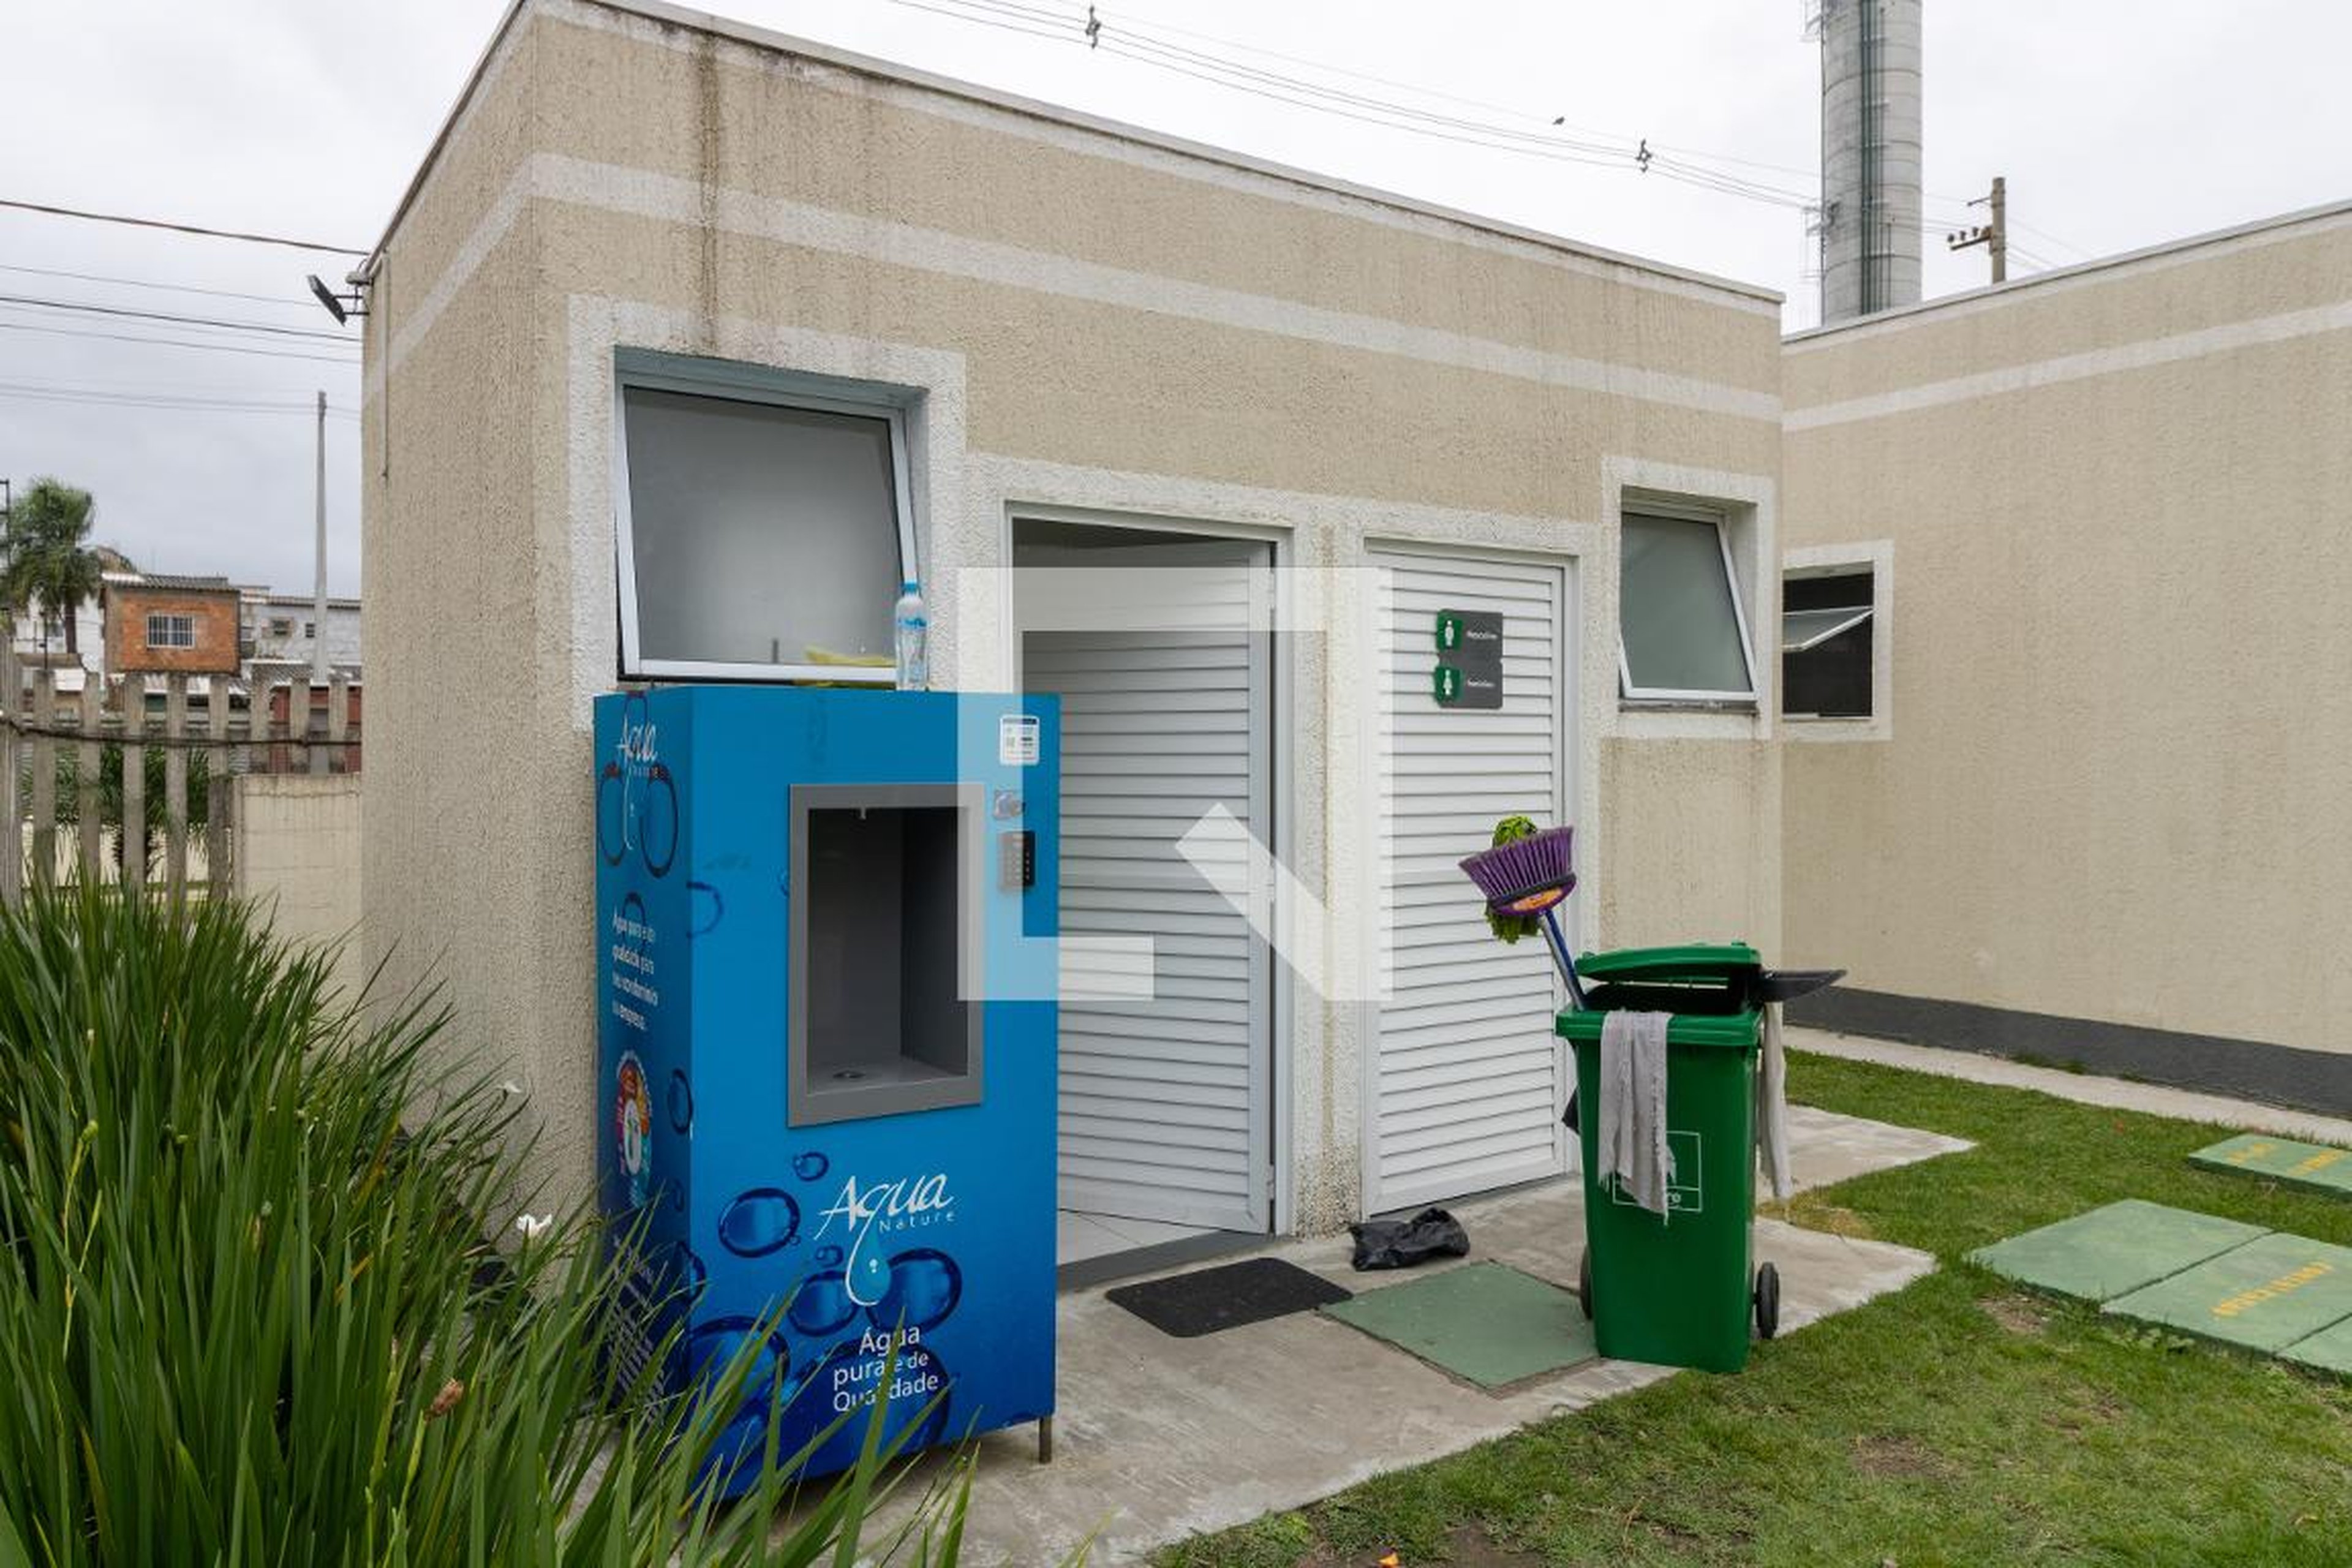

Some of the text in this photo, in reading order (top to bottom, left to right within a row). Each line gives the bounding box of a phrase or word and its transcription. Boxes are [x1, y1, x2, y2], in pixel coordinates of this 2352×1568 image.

[880, 1212, 954, 1234] Nature
[834, 1351, 930, 1392] pura e de
